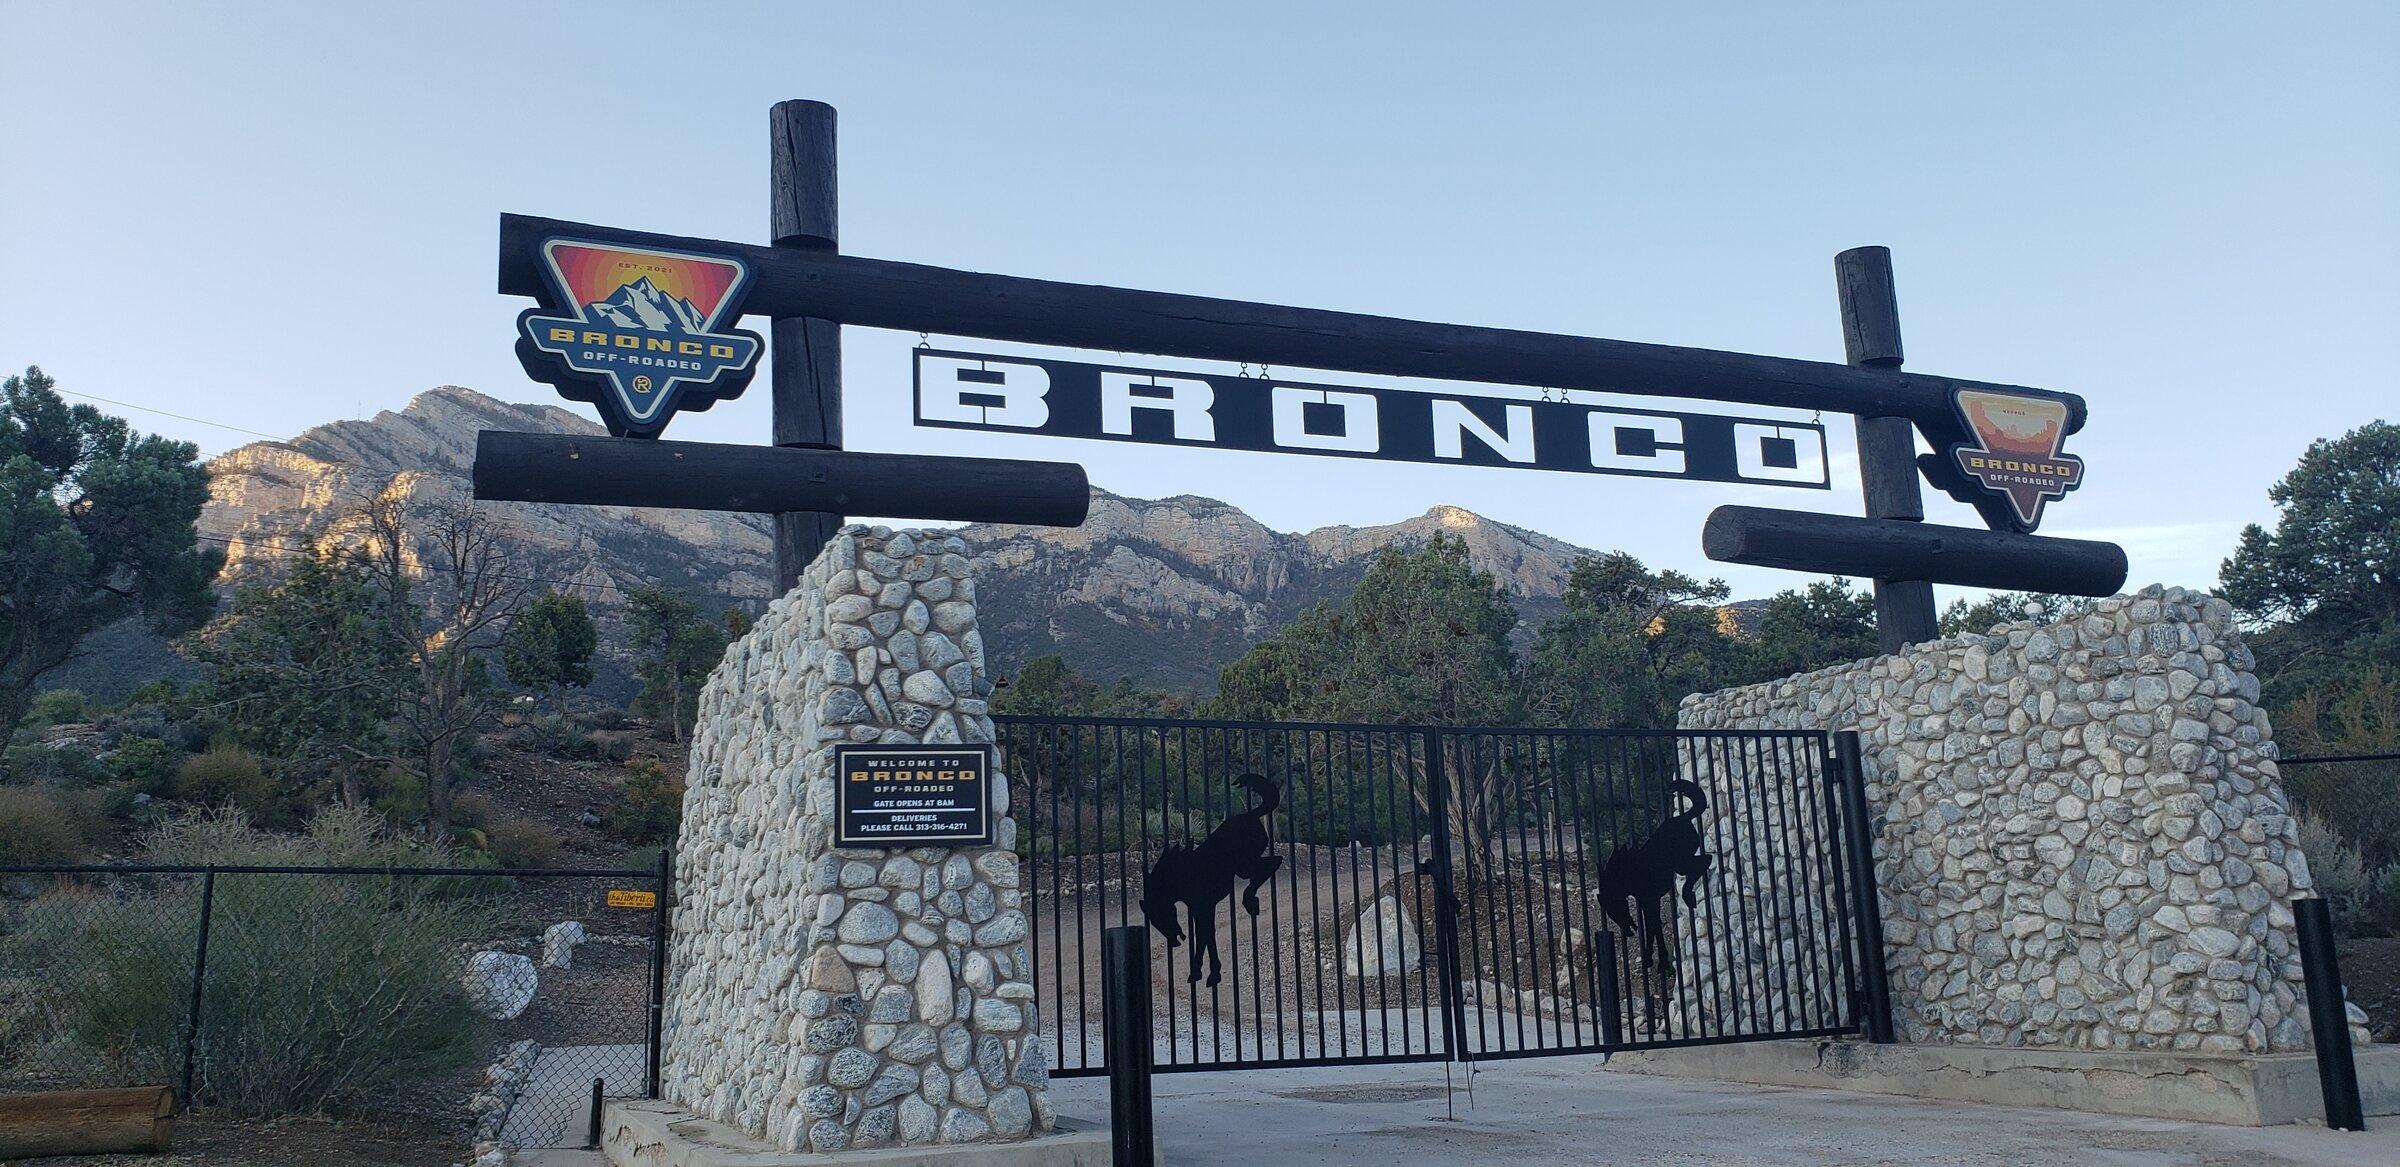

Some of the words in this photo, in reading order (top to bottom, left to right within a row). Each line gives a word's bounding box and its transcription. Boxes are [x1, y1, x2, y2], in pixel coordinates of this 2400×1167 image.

[618, 262, 644, 271] EST.
[646, 265, 672, 274] 2021
[550, 328, 734, 359] BRONCO
[584, 351, 702, 370] OFF-ROADEO
[918, 354, 1822, 484] BRONCO
[1970, 458, 2070, 476] BRONCO
[1990, 474, 2054, 486] OFF-ROADEO
[850, 770, 976, 781] BRONCO
